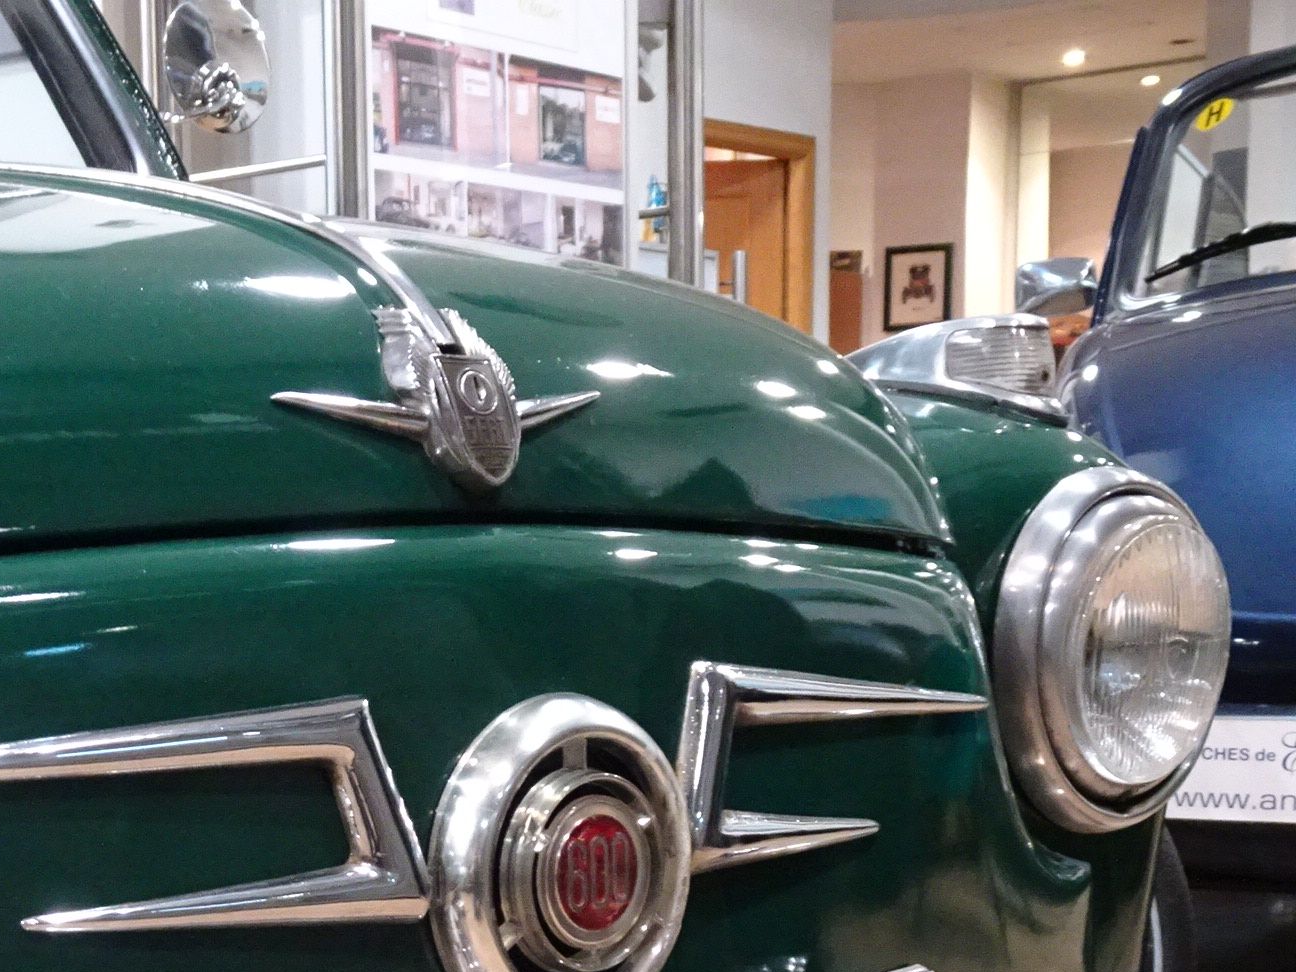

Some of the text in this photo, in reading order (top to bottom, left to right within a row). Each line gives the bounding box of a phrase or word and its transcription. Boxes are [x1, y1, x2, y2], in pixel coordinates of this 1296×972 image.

[1205, 101, 1225, 128] H
[1255, 748, 1276, 761] de
[567, 831, 630, 913] 600
